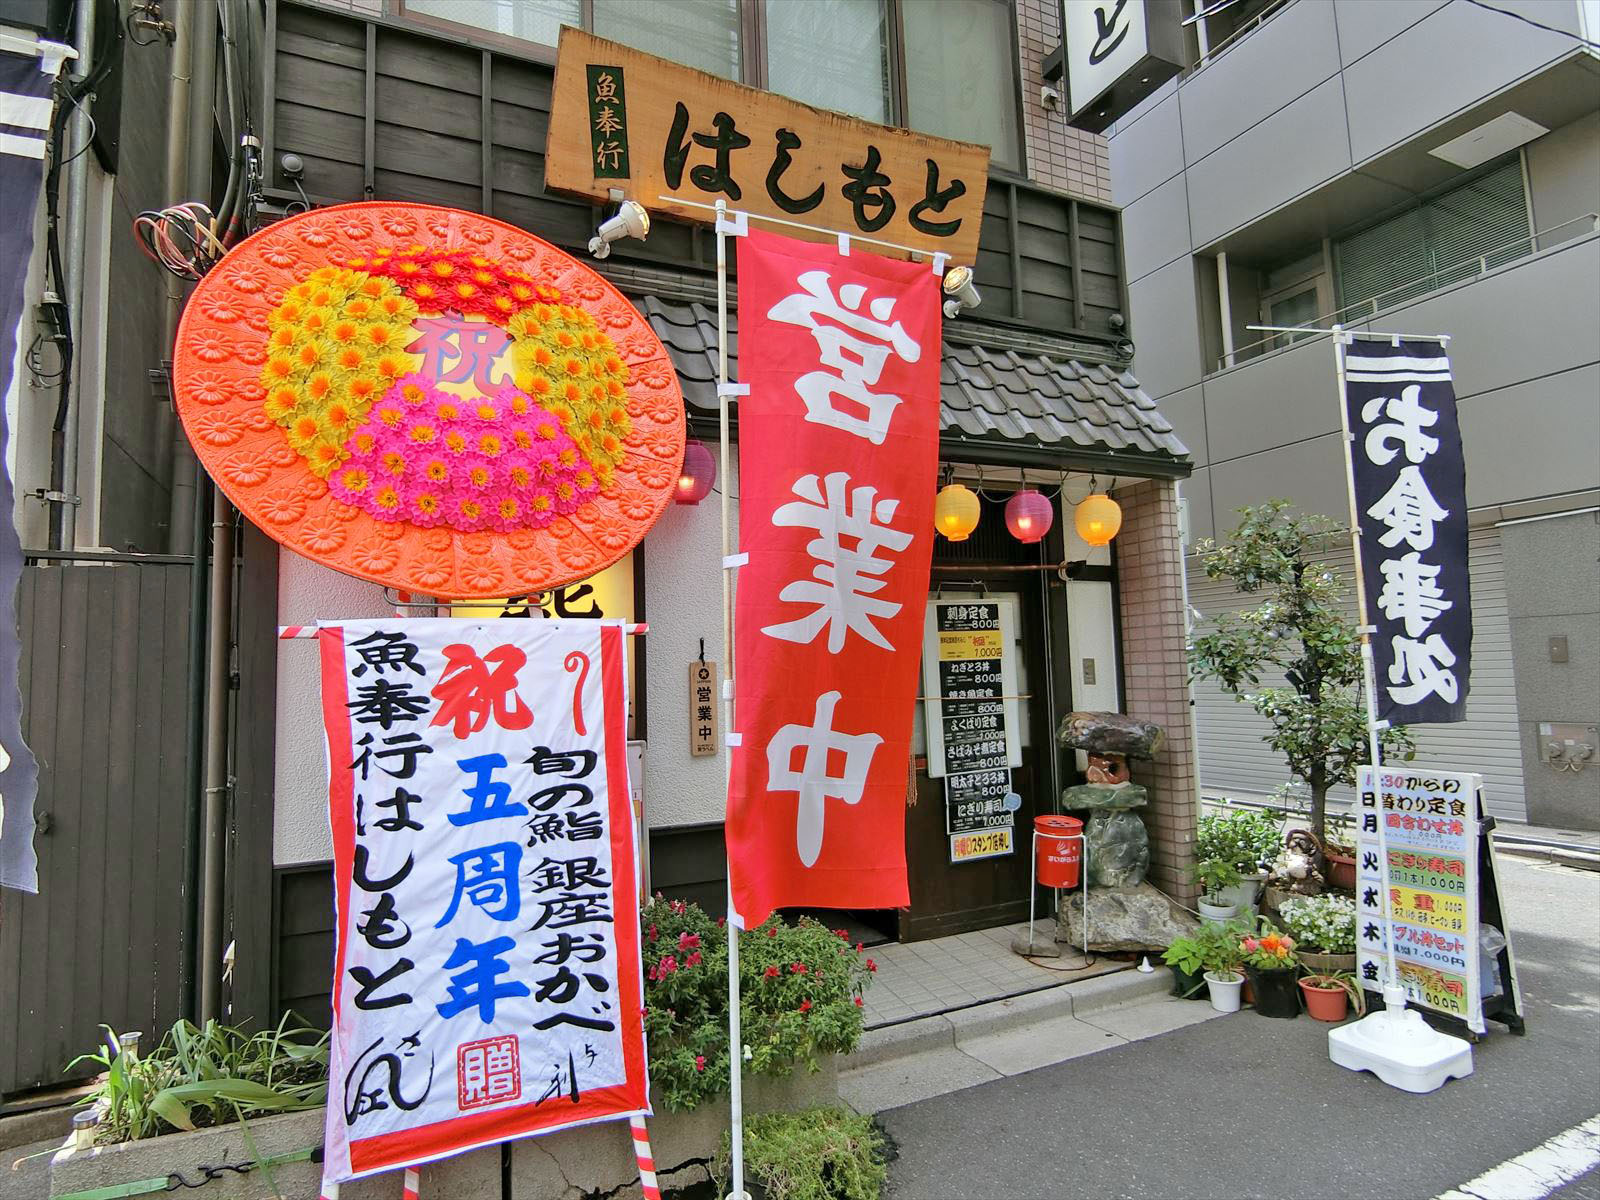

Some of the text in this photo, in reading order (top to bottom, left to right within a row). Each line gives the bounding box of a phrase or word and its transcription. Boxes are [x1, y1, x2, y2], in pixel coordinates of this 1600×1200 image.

[594, 72, 625, 170] 魚奉行
[663, 101, 966, 237] はしもと
[403, 307, 517, 398] 祝
[760, 271, 921, 868] 営業中
[971, 619, 1000, 629] 800円
[951, 661, 991, 673] ねぎとろ丼
[974, 673, 1003, 683] 800円
[697, 686, 712, 741] 営業中
[977, 703, 1005, 713] 800円
[951, 715, 997, 731] よくばり定食
[979, 755, 1008, 768] 800円
[522, 746, 604, 847] 旬の鮨
[981, 785, 1011, 796] 800円
[957, 799, 1003, 817] にぎり寿司
[346, 631, 434, 1010] 魚奉行はしもと
[1363, 813, 1378, 833] 月
[428, 643, 534, 1024] 祝 五周年
[1363, 851, 1378, 872] 火
[1363, 886, 1378, 907] 水
[1363, 921, 1380, 942] 木
[524, 857, 615, 1032] 銀座おかべ
[1362, 960, 1379, 983] 金
